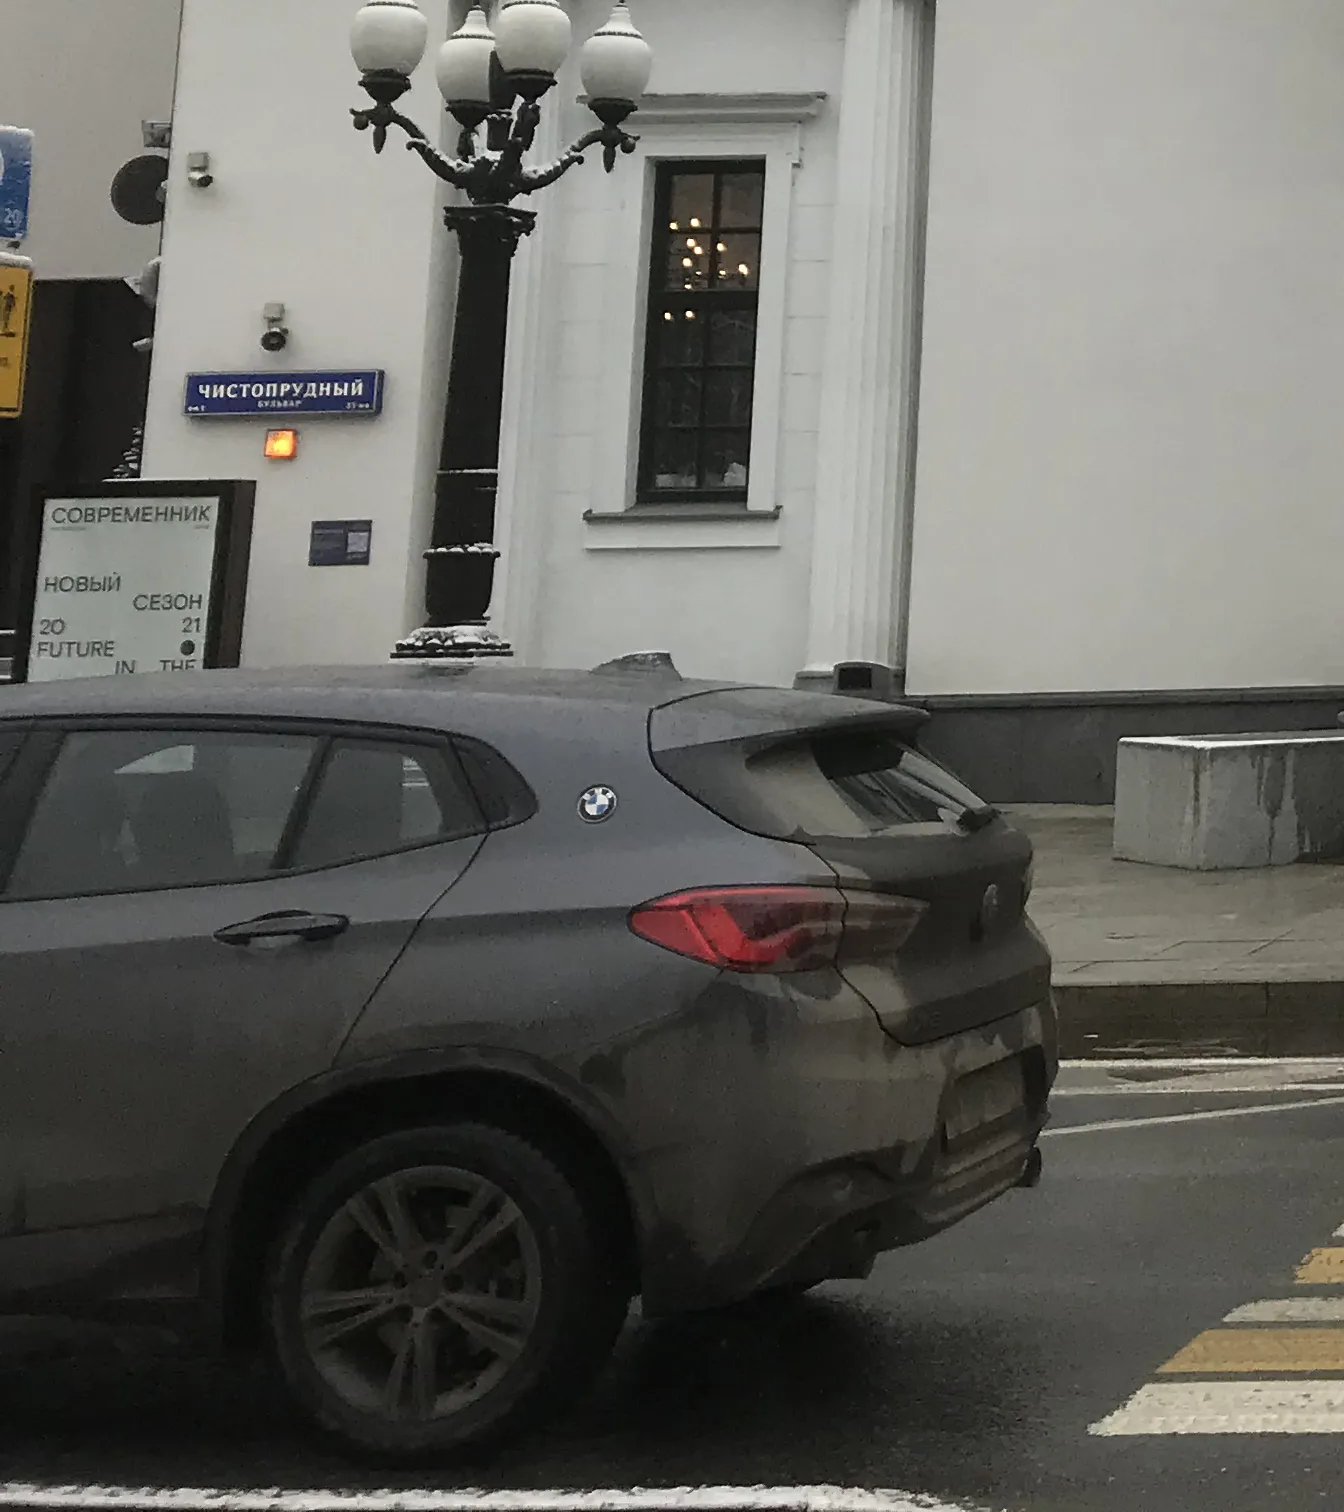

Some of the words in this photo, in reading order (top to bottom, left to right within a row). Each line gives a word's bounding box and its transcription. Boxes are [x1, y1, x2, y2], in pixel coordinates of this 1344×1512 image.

[198, 378, 364, 398] ЧИСТОПРУДНЫЙ
[51, 505, 212, 524] СОВРЕМЕННИК
[43, 571, 122, 593] НОВЫЙ
[132, 593, 203, 611] СЕЗОН
[39, 617, 66, 636] 20
[181, 616, 201, 634] 21
[37, 639, 115, 658] FUTURE
[114, 660, 136, 675] IN
